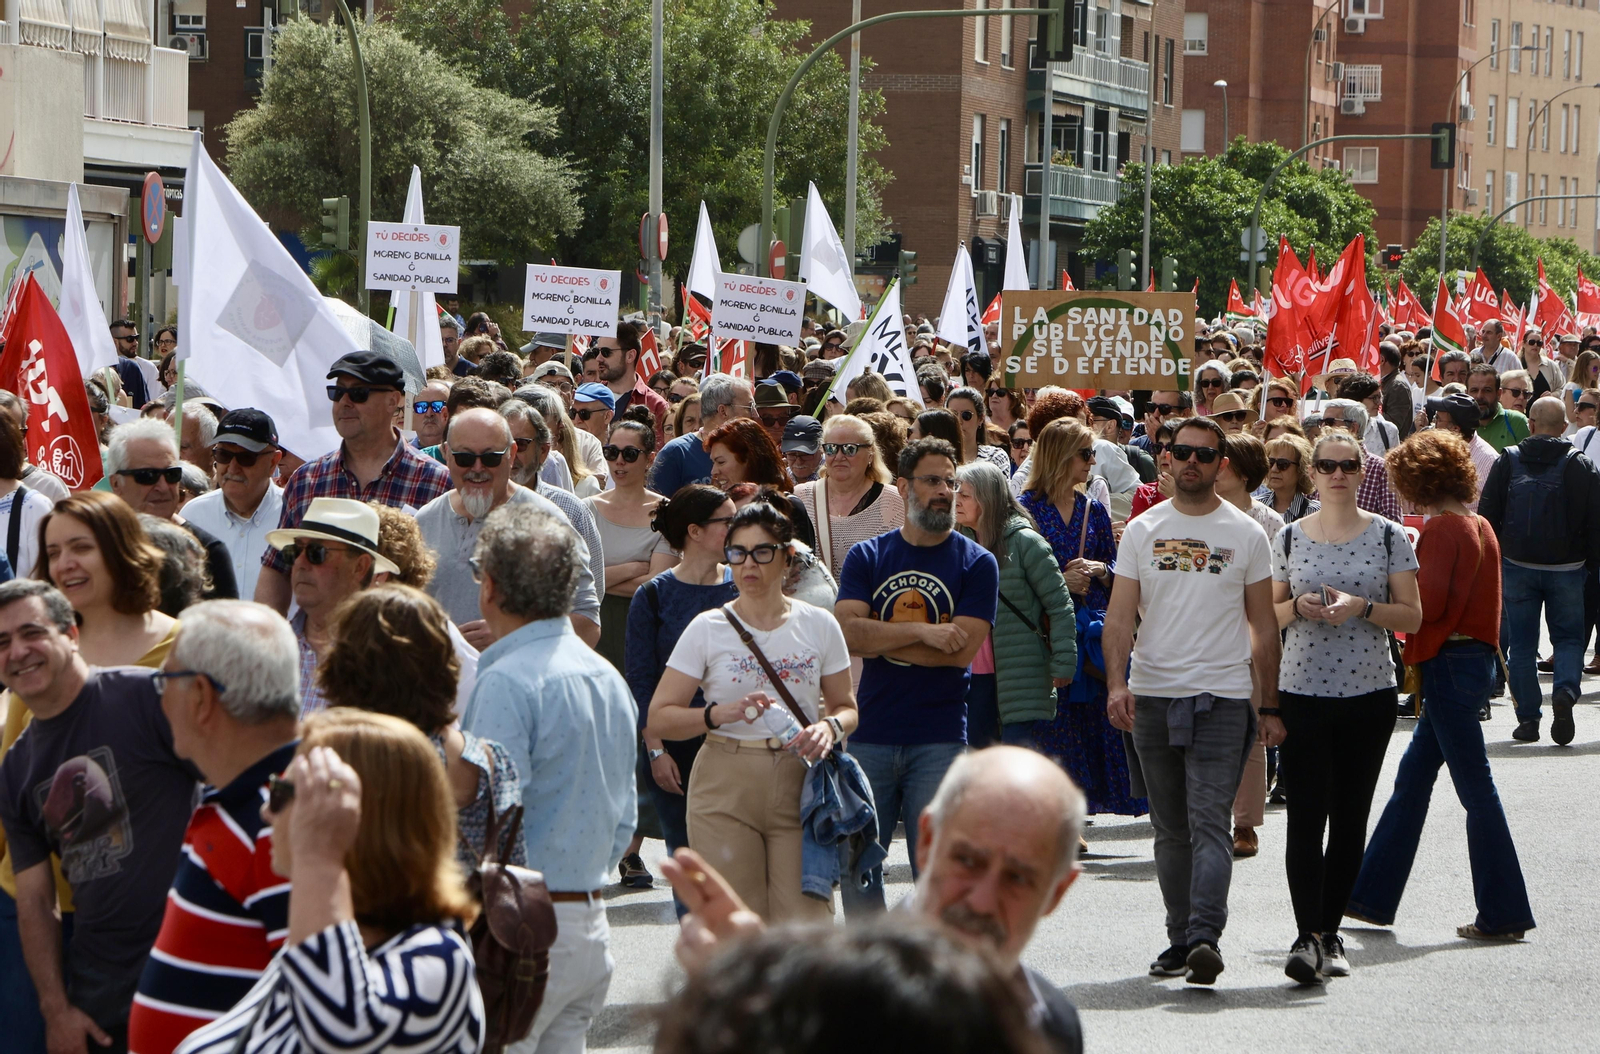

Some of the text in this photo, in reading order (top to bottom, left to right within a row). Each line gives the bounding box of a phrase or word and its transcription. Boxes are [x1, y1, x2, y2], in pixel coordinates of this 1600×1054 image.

[391, 232, 430, 242] DECIDES
[373, 250, 452, 261] MORENO BONILLA
[373, 273, 450, 284] SANIDAD PUBLICA
[551, 275, 590, 286] DECIDES
[739, 284, 777, 296] DECIDES
[531, 292, 612, 306] MORENO BONILLA
[720, 299, 797, 316] MORENO BONILLA
[530, 315, 610, 328] SANIDAD PUBLICA
[1014, 306, 1183, 326] LA SANIDAD
[717, 321, 793, 338] SANIDAD PUBLICA
[1012, 323, 1185, 342] PUBLICA NO
[1032, 339, 1164, 359] SE VENDE
[1005, 356, 1038, 374] SE
[881, 575, 941, 598] I CHOOSE
